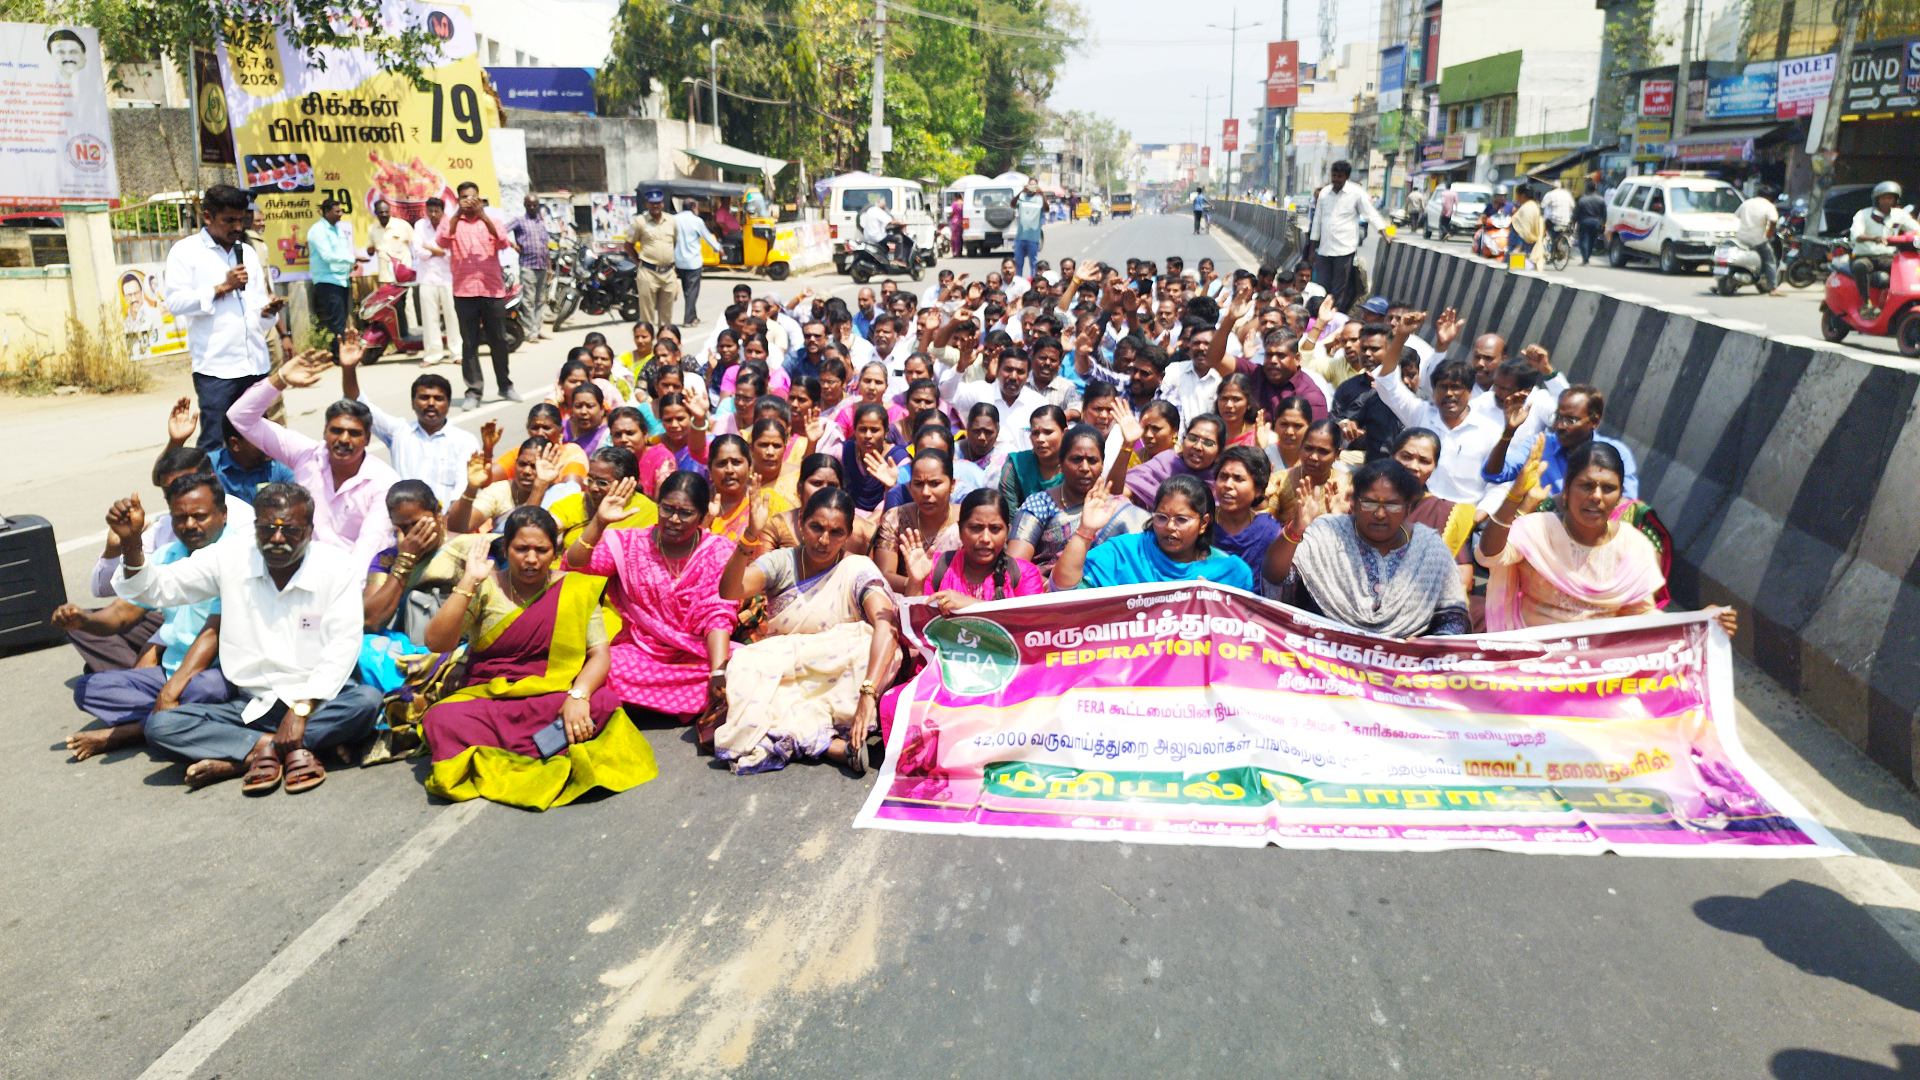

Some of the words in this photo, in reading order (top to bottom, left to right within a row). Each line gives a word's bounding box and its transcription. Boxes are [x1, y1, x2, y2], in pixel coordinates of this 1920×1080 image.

[236, 56, 274, 71] 6,7,8
[1782, 56, 1833, 77] TOLET
[1850, 57, 1900, 83] UND
[239, 73, 278, 86] 2026
[267, 117, 405, 144] பிரியாணி
[417, 83, 484, 144] 79
[300, 91, 399, 117] சிக்கன்
[447, 157, 474, 169] 200
[264, 197, 311, 210] சிக்கன்
[1126, 590, 1192, 610] ஒற்றுமையே
[1196, 589, 1222, 602] பலம்
[1023, 609, 1267, 648] வருவாய்த்துறை
[1284, 632, 1495, 672] சங்கங்களின்
[942, 651, 1000, 676] ERA
[1044, 639, 1212, 668] FEDERATION
[1217, 643, 1254, 662] OF
[1261, 647, 1385, 687] REVENUE
[1392, 673, 1589, 693] ASSOCIATION
[1596, 671, 1689, 697] (FERA)
[1077, 699, 1105, 714] FERA
[1108, 700, 1211, 719] கூட்டமைப்பின்
[1372, 690, 1438, 708] மாவட்டம்
[973, 731, 1027, 748] 42,000
[1030, 731, 1149, 760] வருவாய்த்துறை
[1153, 734, 1251, 762] அலுவலர்கள்
[1463, 752, 1543, 781] மாவட்ட
[1545, 747, 1673, 784] தலைநகரில்
[998, 770, 1247, 800] மறியல்
[1258, 772, 1655, 808] போராட்டம்
